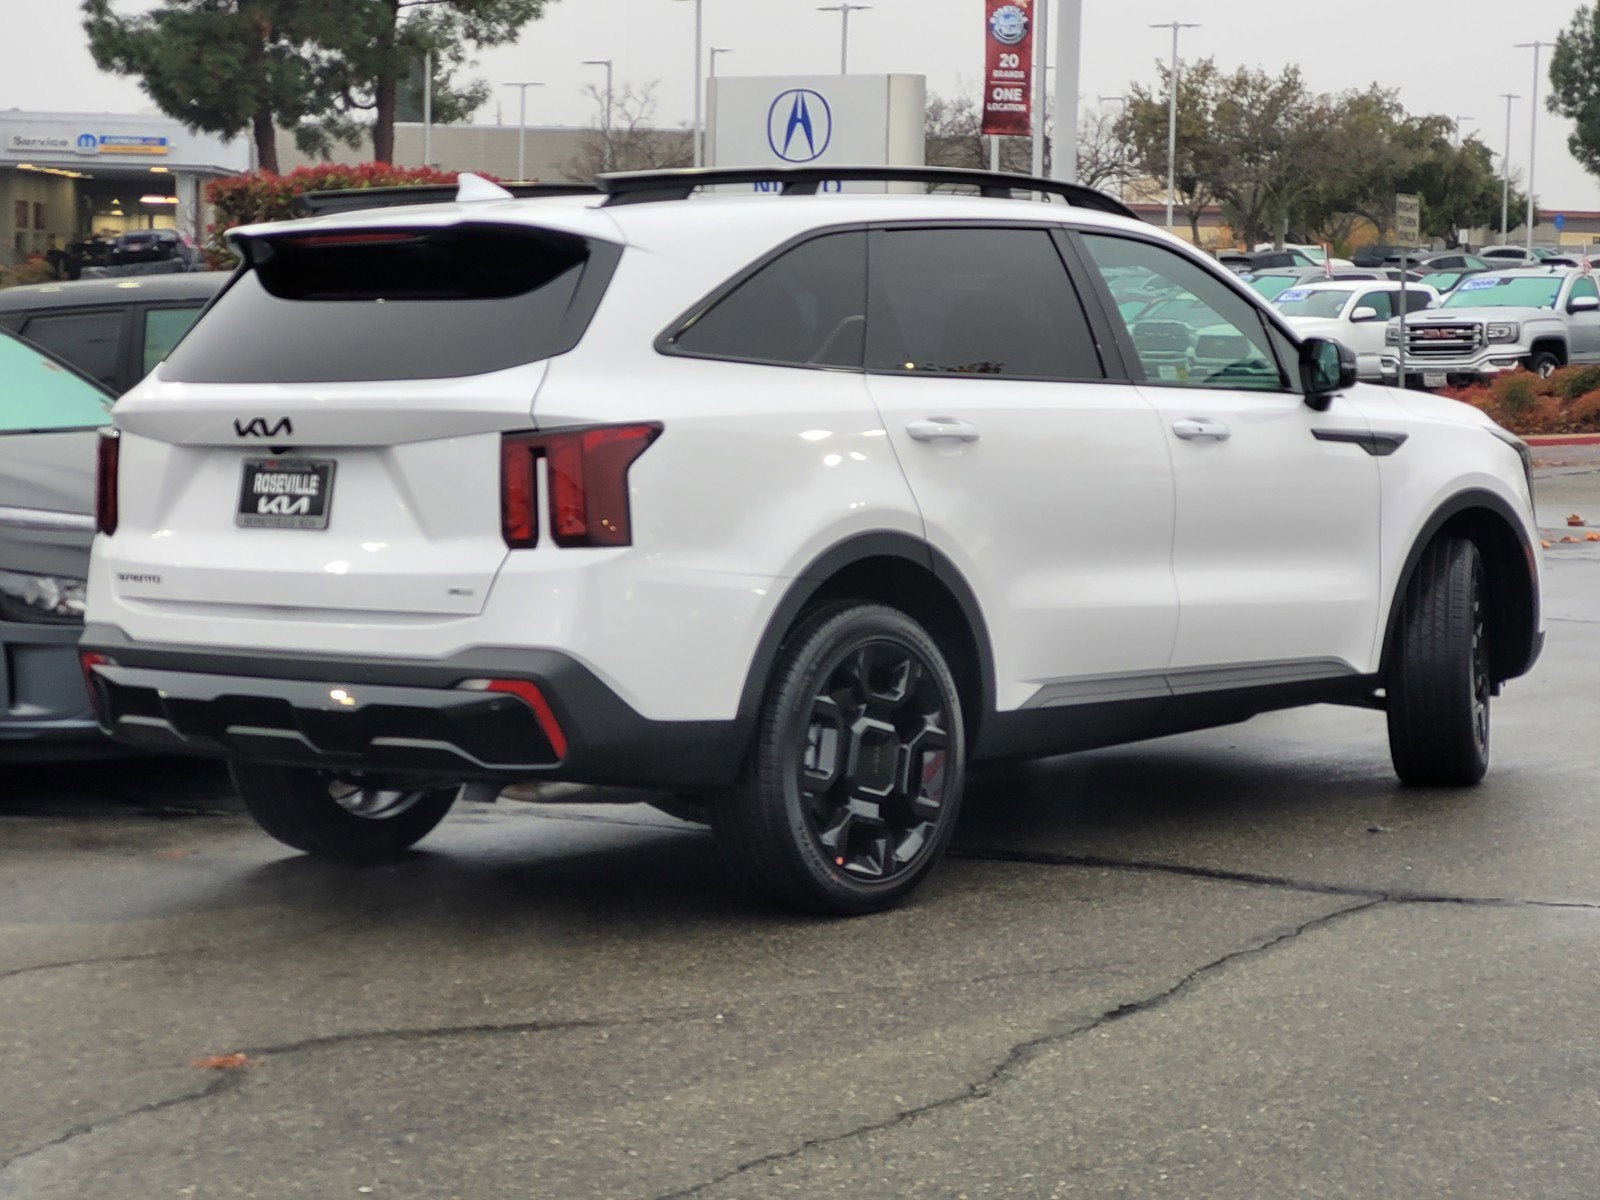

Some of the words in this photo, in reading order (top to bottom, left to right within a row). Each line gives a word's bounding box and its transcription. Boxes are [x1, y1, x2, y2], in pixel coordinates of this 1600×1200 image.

[999, 53, 1020, 69] 20
[992, 69, 1026, 79] BRANDS
[992, 87, 1024, 102] ONE
[986, 102, 1027, 112] LOCATION
[12, 134, 69, 147] Service
[233, 416, 293, 437] KIA
[253, 472, 321, 496] ROSEVILLE
[257, 495, 311, 515] KIA
